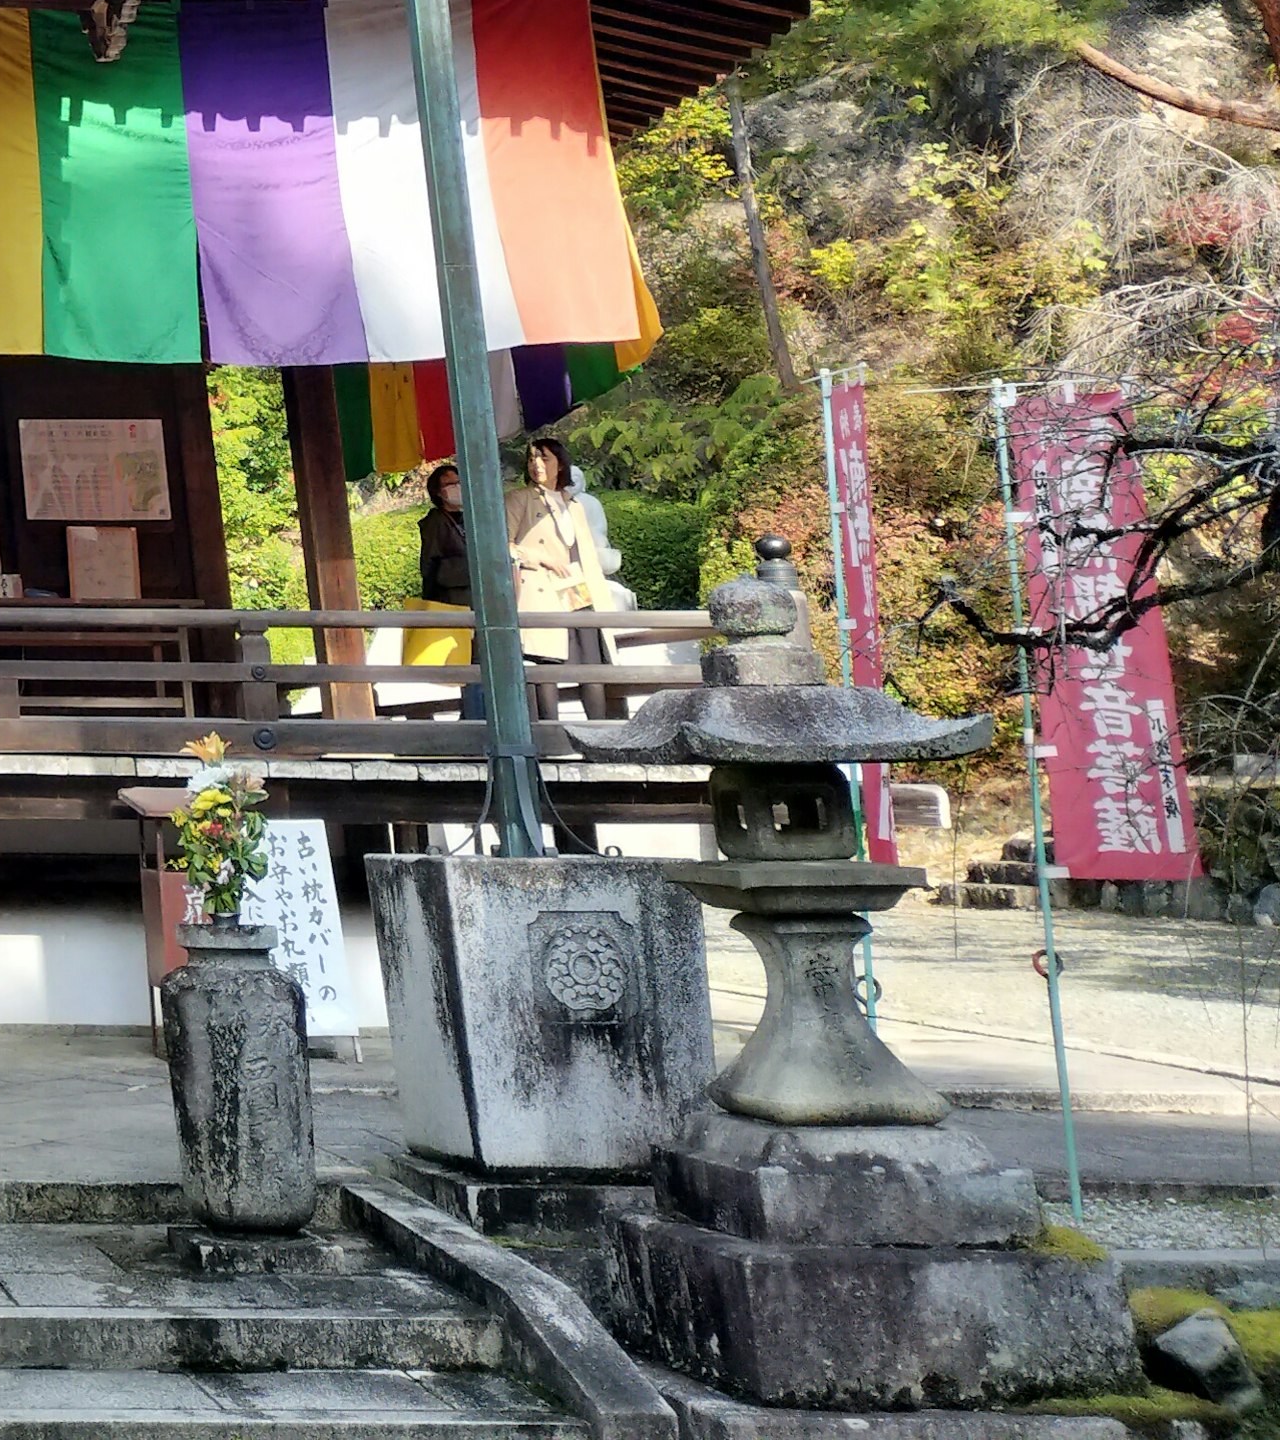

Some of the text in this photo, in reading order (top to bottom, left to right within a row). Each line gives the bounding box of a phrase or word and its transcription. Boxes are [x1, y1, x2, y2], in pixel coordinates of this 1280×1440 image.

[296, 830, 338, 1002] 古い枕カバーの
